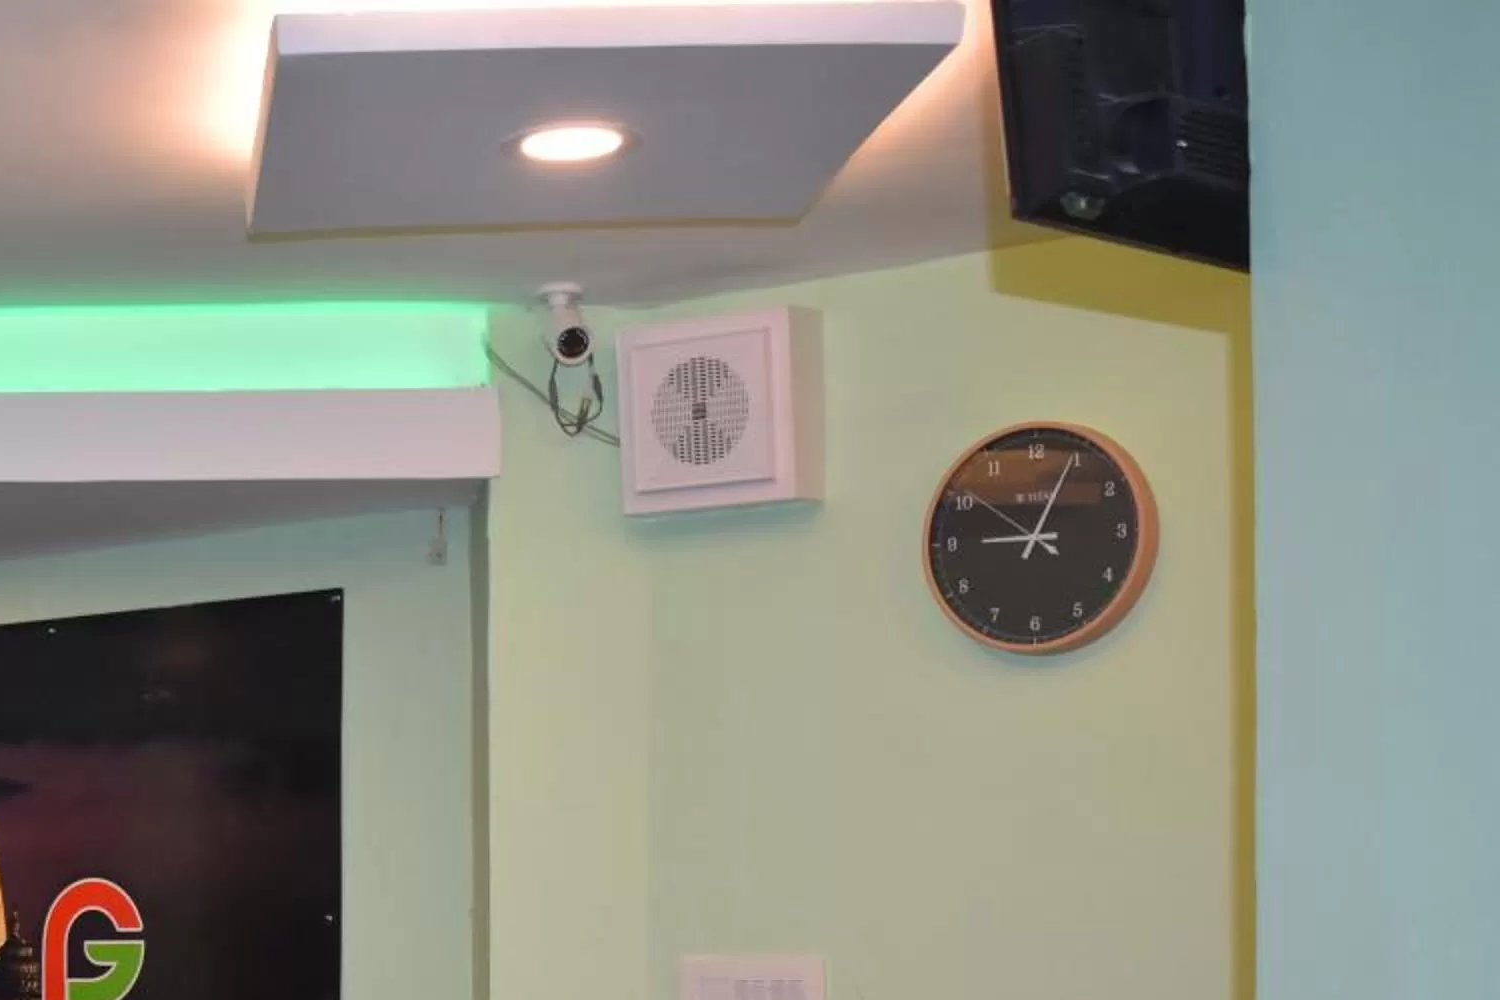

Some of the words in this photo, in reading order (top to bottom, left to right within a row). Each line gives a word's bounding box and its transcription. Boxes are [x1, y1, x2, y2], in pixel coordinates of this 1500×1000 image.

[1028, 444, 1045, 459] 12
[988, 461, 1000, 477] 11
[1104, 481, 1116, 497] 2
[956, 495, 973, 511] 10
[1116, 523, 1127, 538] 3
[947, 537, 957, 552] 9
[1103, 566, 1113, 582] 4
[958, 578, 970, 594] 8
[989, 607, 1000, 622] 7
[1072, 602, 1083, 617] 5
[1029, 616, 1040, 631] 6
